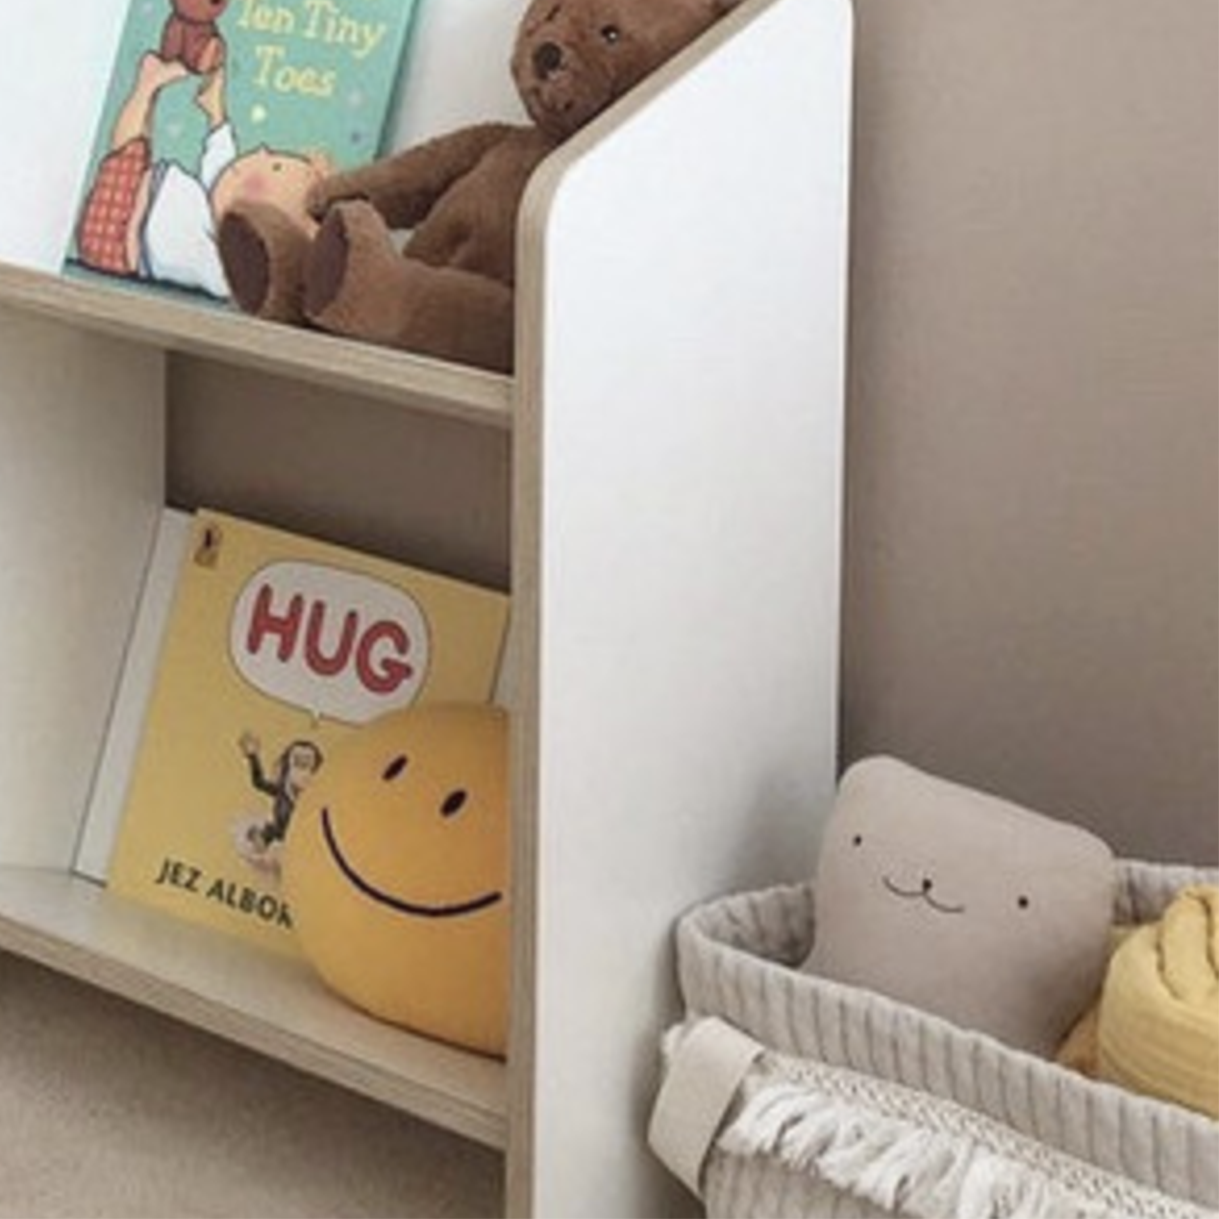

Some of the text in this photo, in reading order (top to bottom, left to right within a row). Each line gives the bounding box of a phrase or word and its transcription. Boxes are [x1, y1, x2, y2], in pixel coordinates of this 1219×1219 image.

[252, 43, 337, 98] Toes
[246, 583, 415, 695] HUG
[154, 855, 203, 893] JEZ
